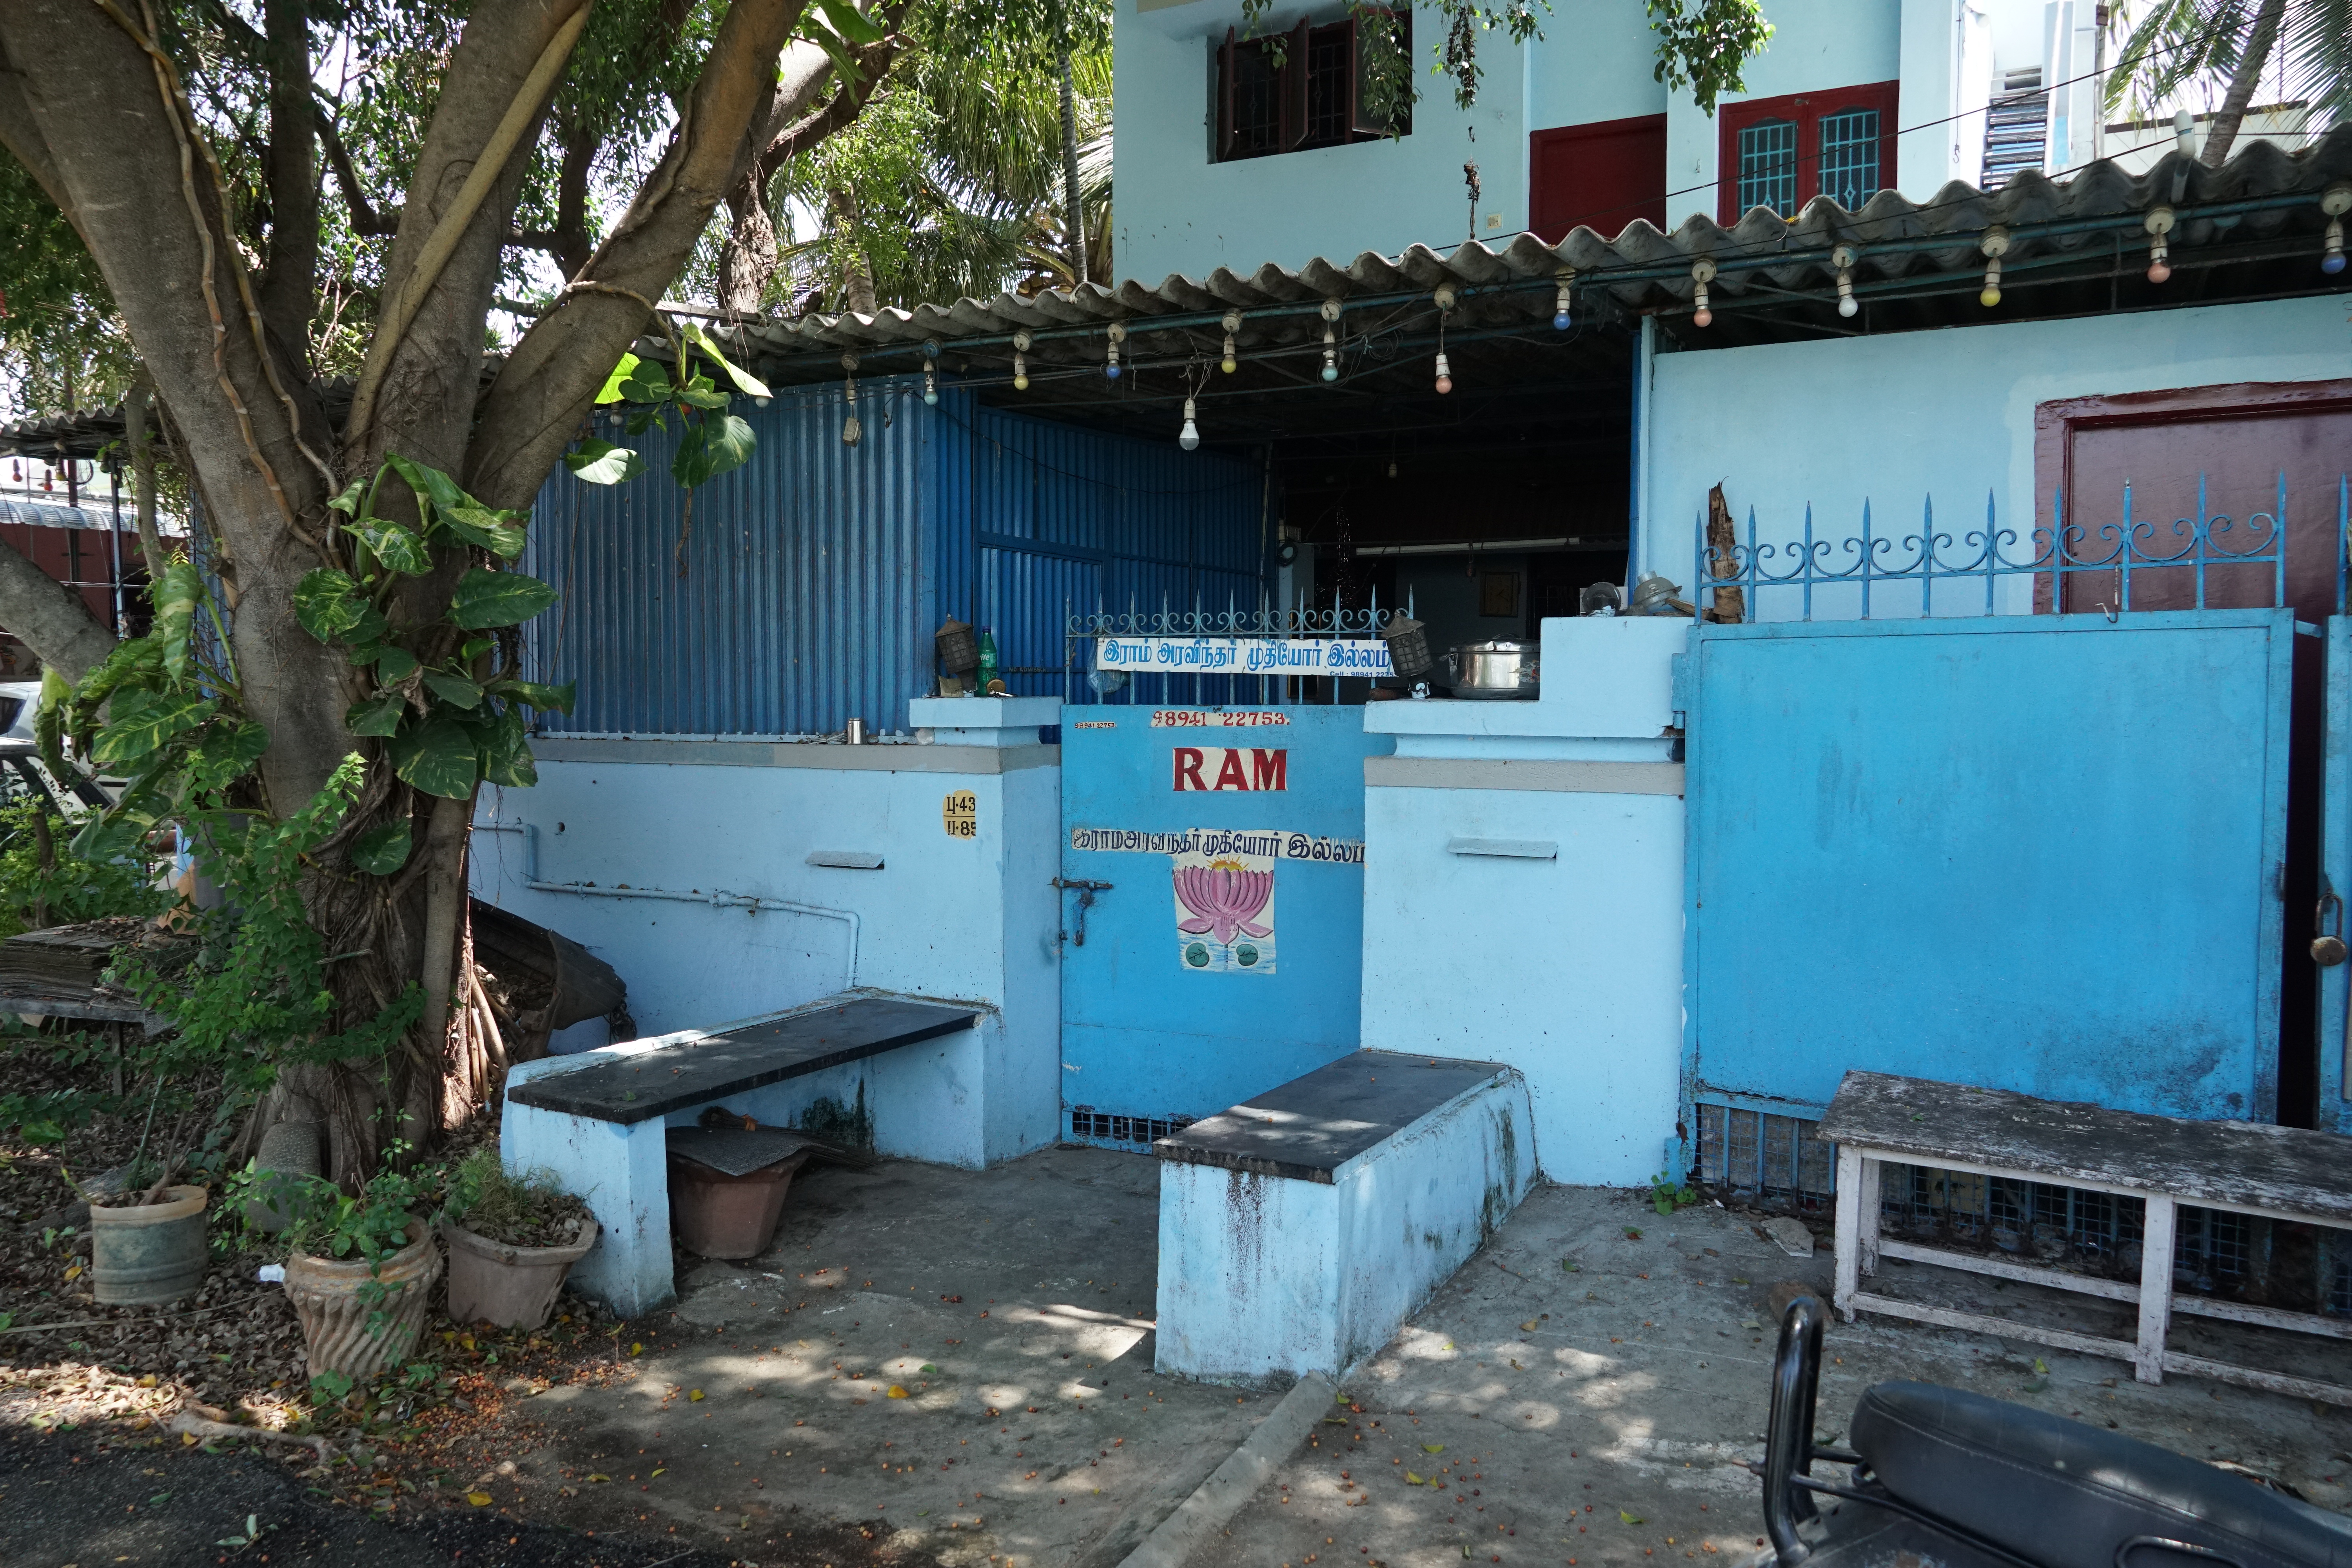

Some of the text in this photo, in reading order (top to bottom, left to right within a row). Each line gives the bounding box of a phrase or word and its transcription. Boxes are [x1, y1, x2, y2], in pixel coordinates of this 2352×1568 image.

[1103, 638, 1152, 665] இராம்
[1247, 639, 1322, 671] முதியோர்
[1152, 711, 1207, 726] 98941
[1173, 747, 1287, 791] RAM
